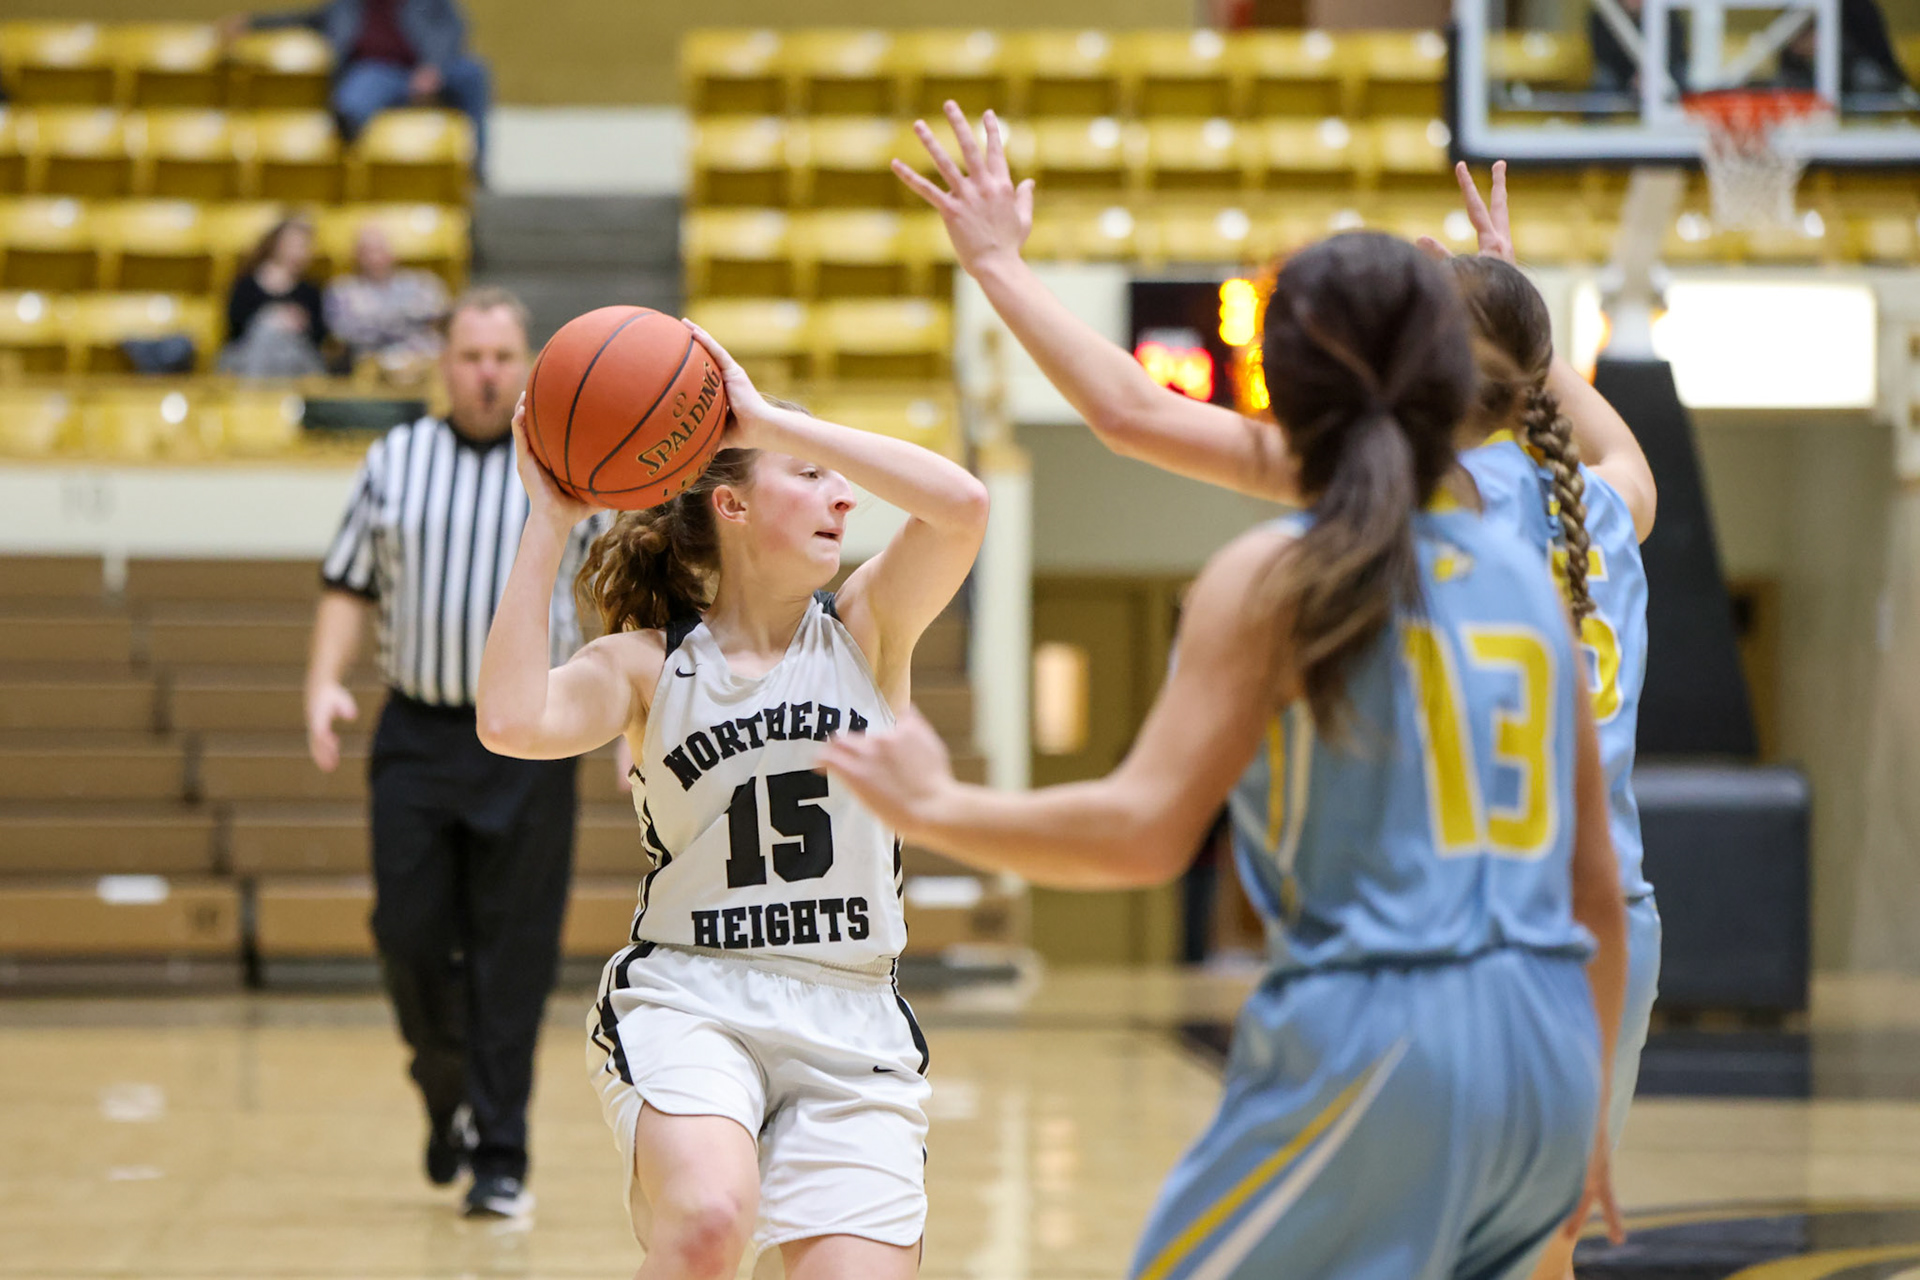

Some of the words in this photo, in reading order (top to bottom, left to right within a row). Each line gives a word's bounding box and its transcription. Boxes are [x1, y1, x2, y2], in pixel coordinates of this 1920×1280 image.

[637, 361, 722, 476] SPALDING
[1403, 623, 1557, 858] 13
[724, 767, 833, 889] 15
[691, 897, 869, 950] HEIGHTS
